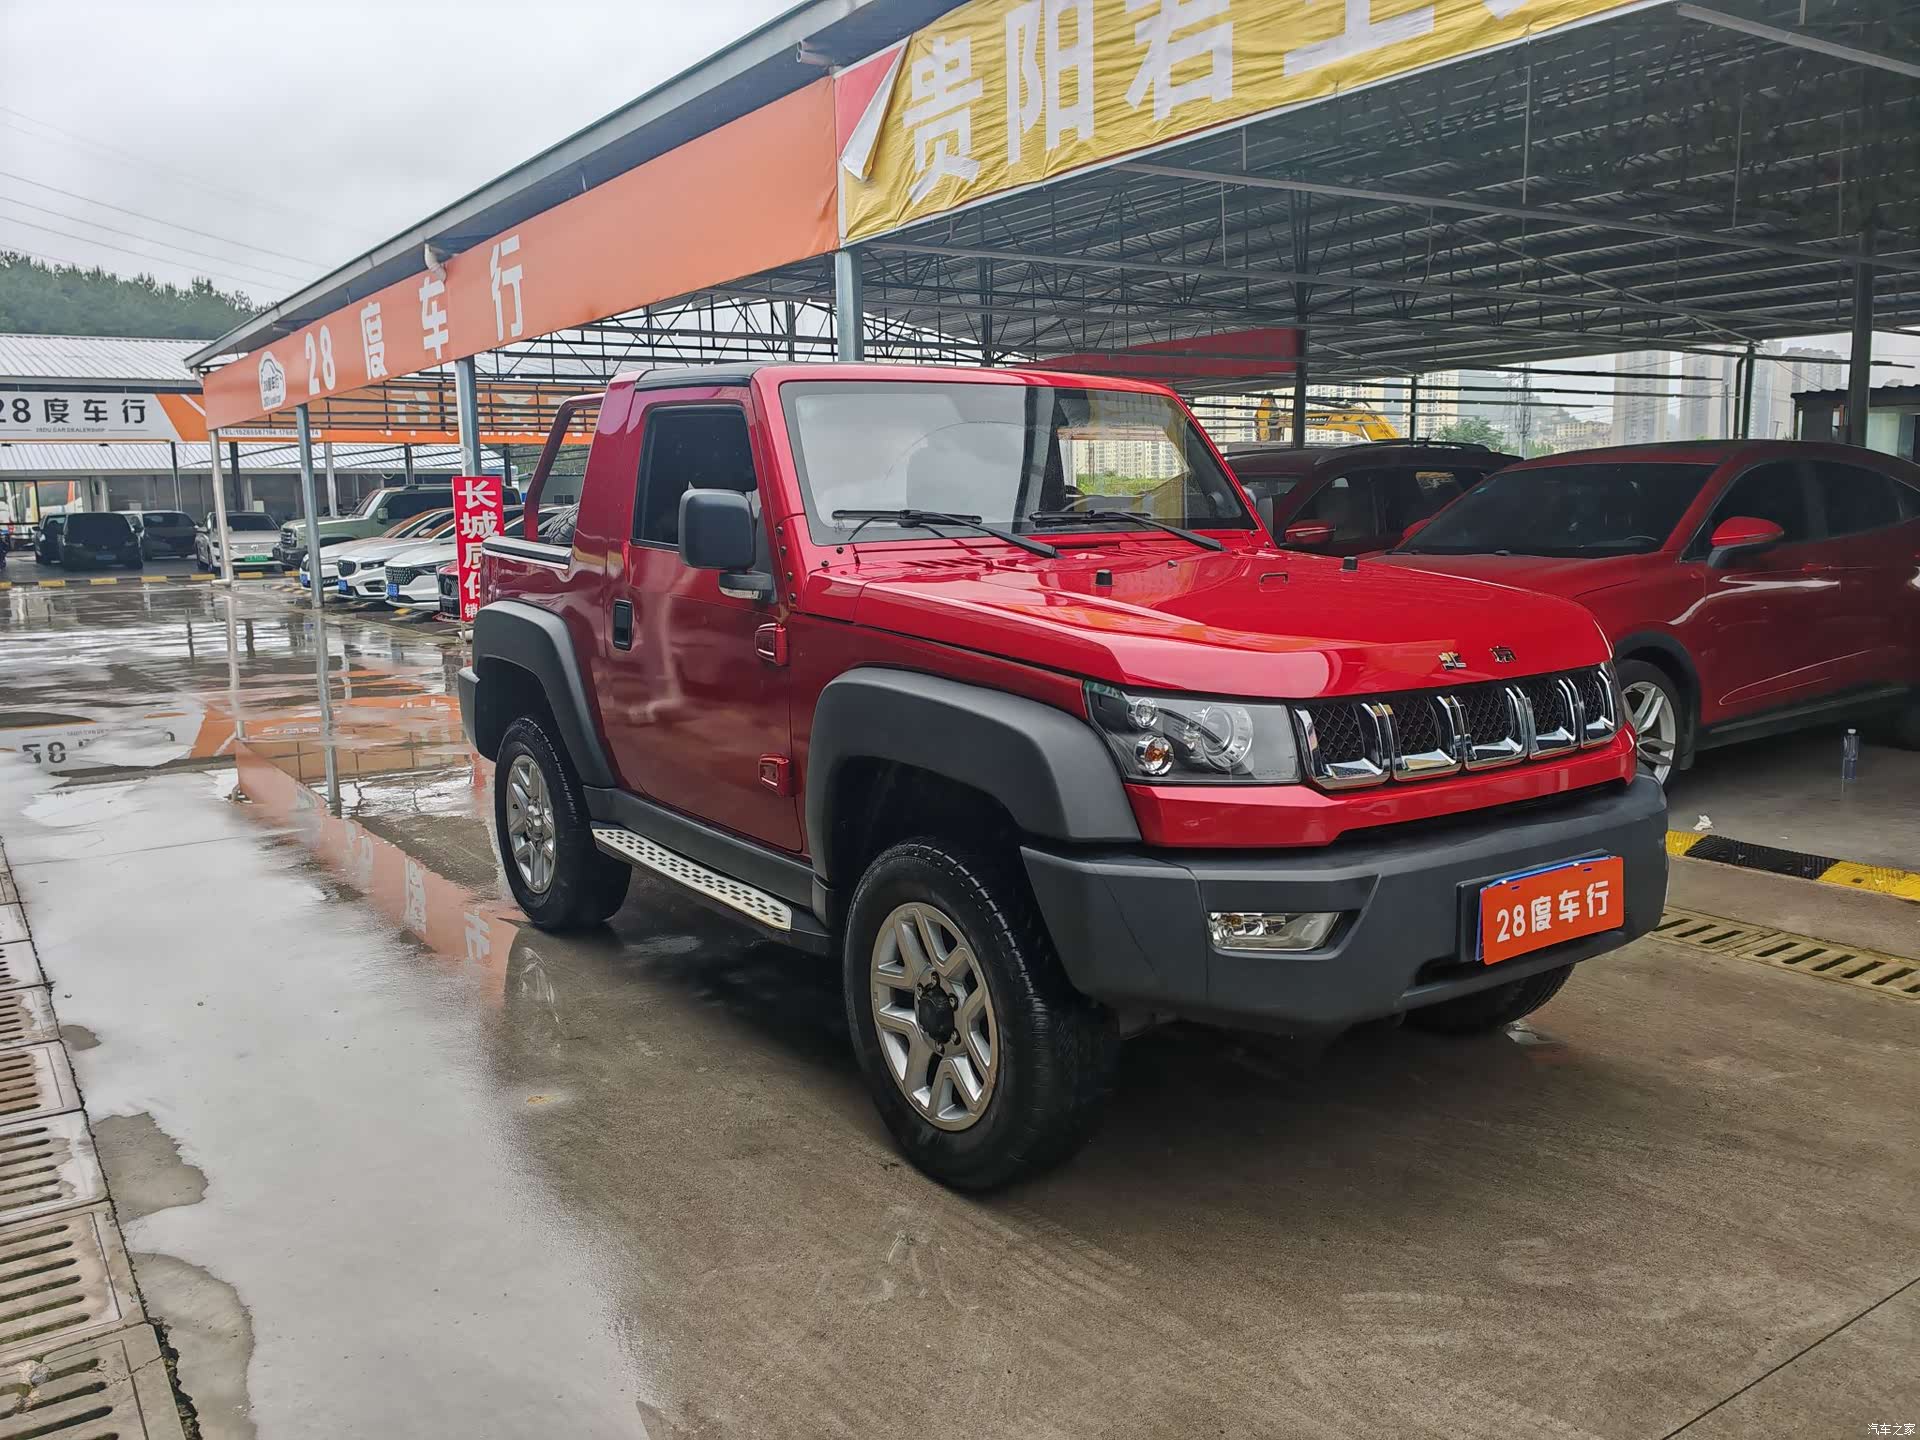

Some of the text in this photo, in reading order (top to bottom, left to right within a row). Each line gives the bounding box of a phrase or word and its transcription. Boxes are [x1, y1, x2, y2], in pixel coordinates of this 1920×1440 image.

[304, 234, 523, 396] 28度车行
[1496, 880, 1609, 943] 28度车行
